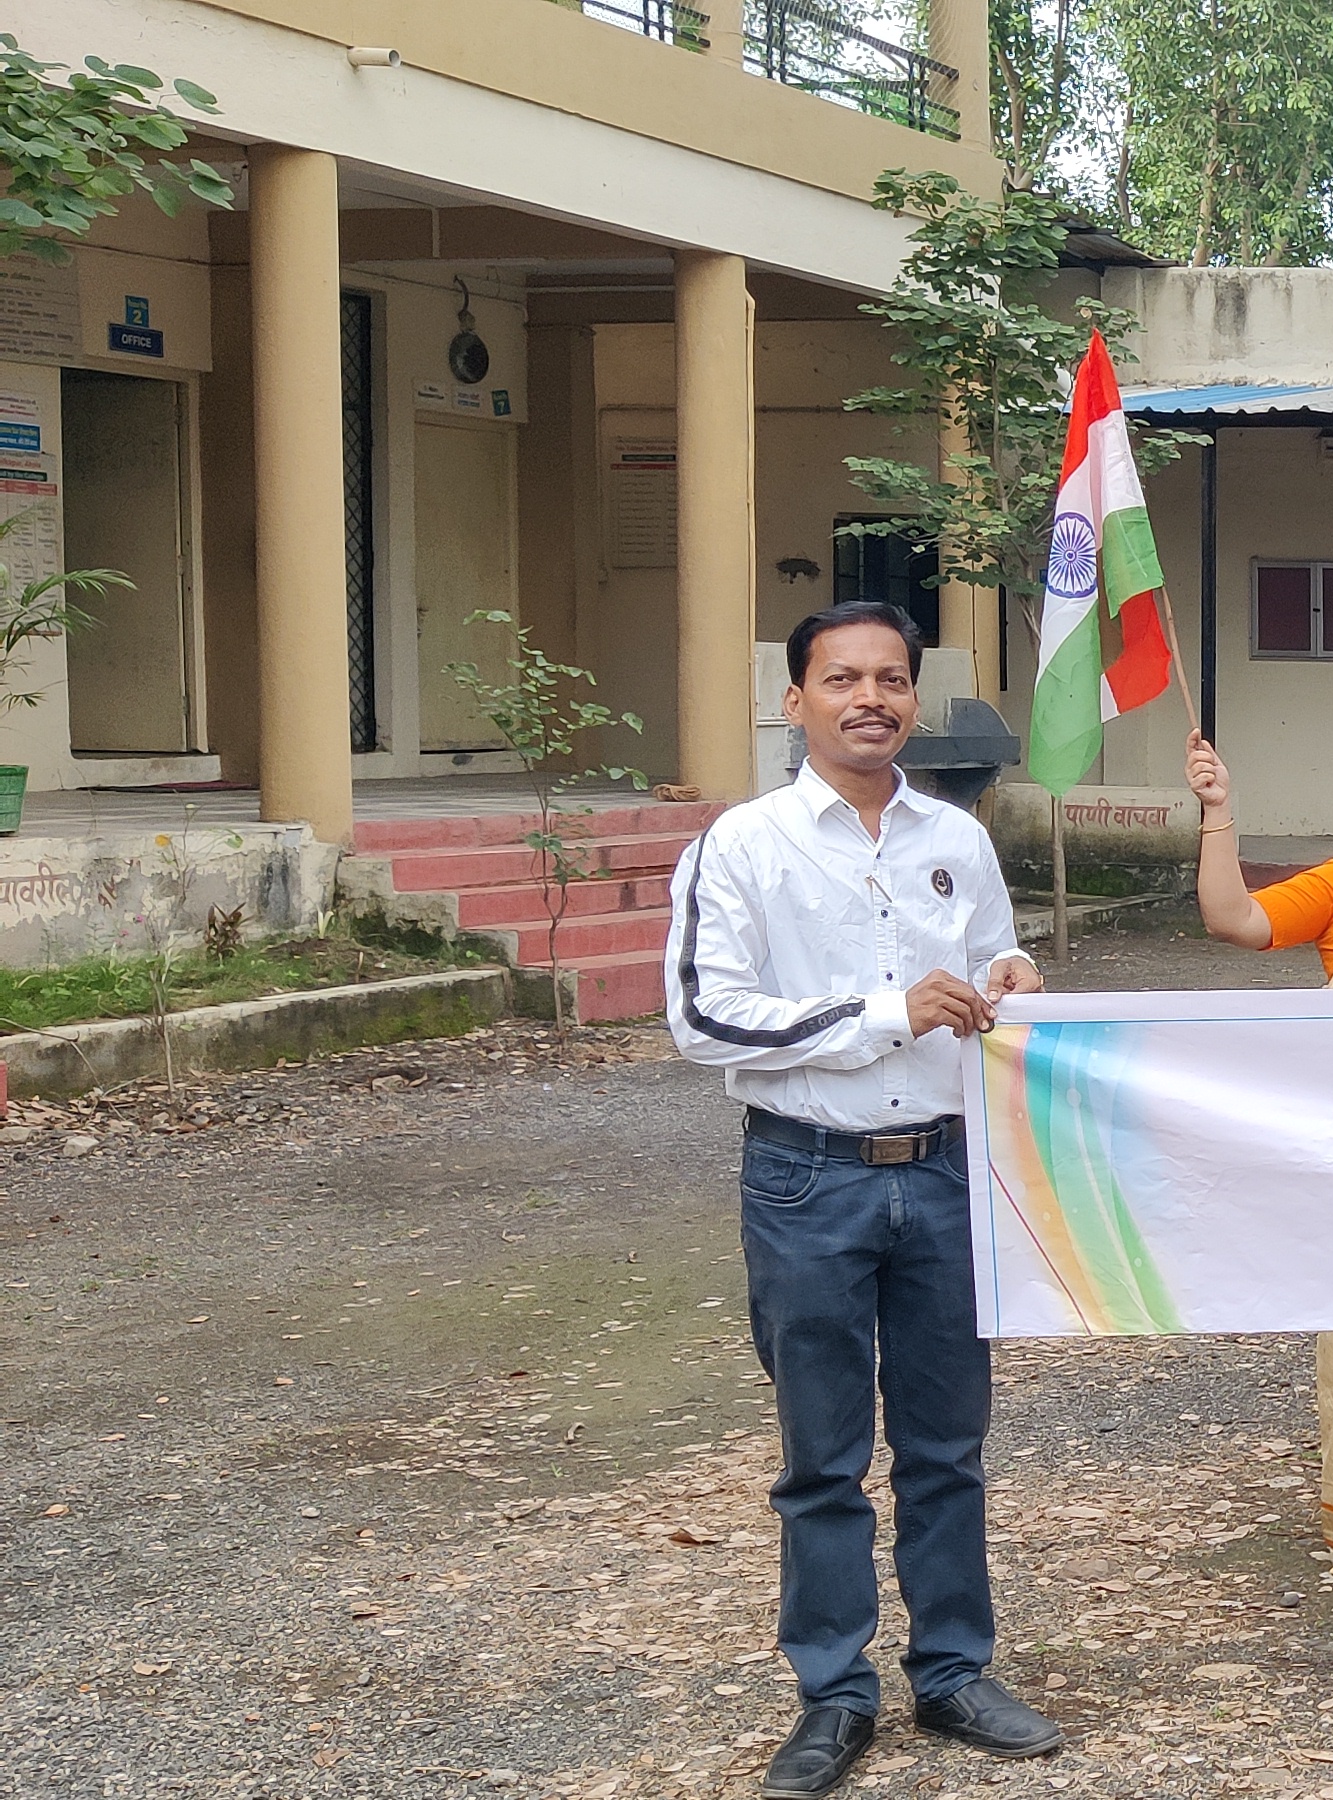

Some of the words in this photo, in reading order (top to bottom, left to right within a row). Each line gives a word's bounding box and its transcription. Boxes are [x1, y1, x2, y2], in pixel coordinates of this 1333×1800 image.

[133, 310, 143, 324] 2
[121, 334, 152, 348] OFFICE
[1064, 797, 1112, 828] पाणी
